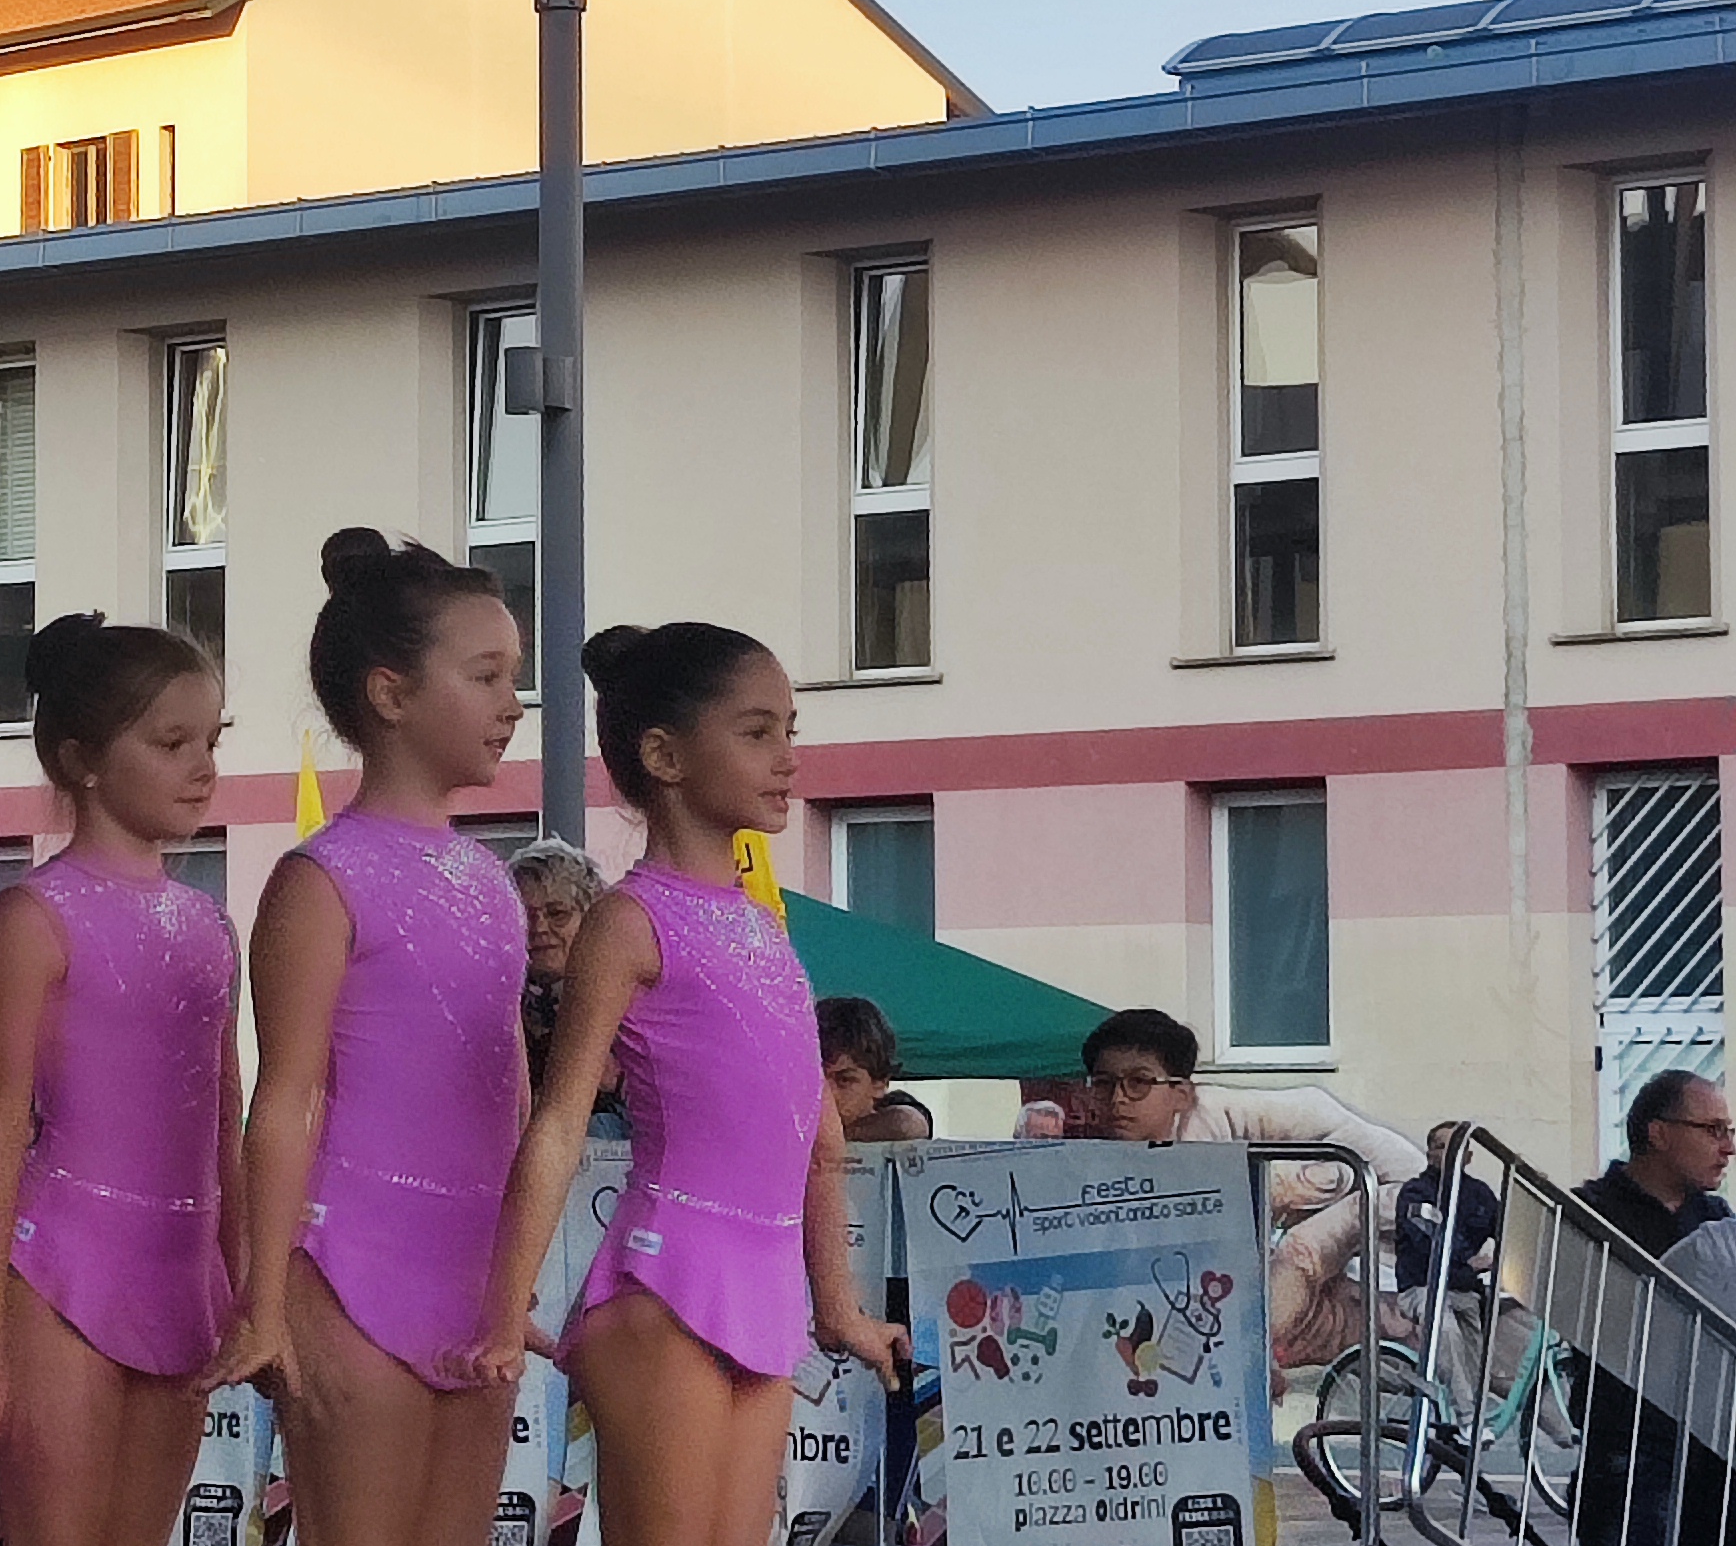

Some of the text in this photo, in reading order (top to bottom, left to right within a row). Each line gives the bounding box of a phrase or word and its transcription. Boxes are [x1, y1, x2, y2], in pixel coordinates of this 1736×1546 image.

[952, 1406, 1232, 1461] 21 e 22 settembre
[1013, 1467, 1077, 1497] 10.00
[1104, 1460, 1169, 1492] 19.00
[1014, 1501, 1087, 1532] piazza
